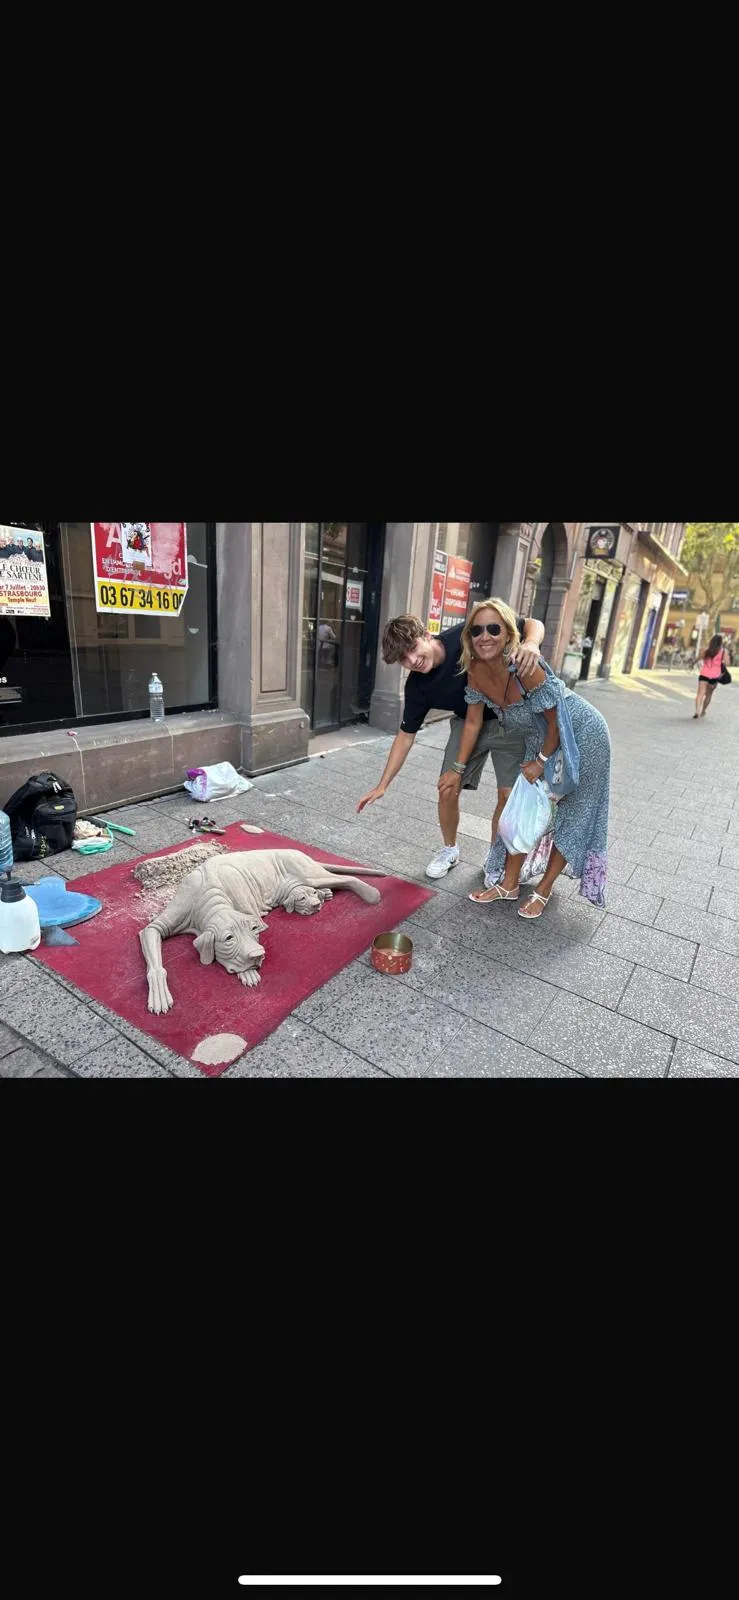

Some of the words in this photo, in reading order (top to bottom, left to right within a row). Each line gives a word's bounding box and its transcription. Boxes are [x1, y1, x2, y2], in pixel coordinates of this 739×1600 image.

[100, 585, 117, 605] 03
[120, 587, 135, 607] 67
[139, 589, 153, 608] 34
[156, 591, 170, 609] 16
